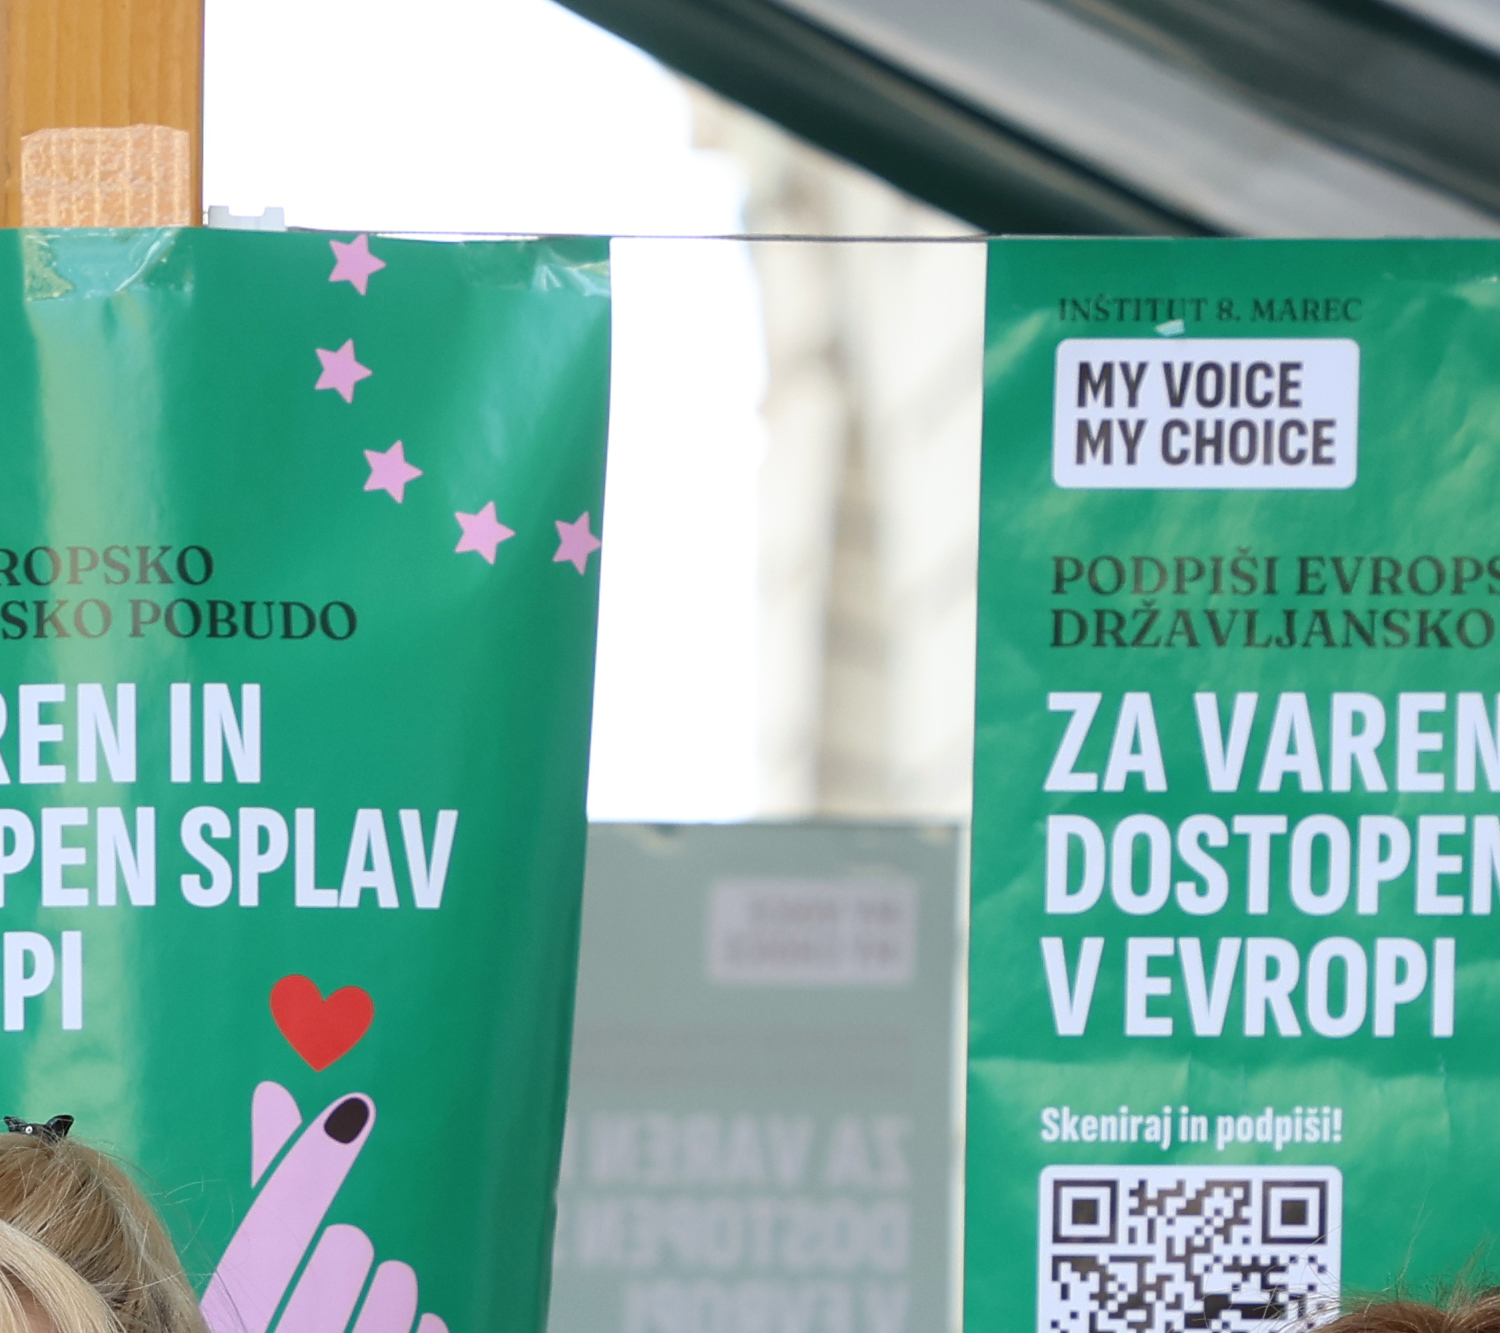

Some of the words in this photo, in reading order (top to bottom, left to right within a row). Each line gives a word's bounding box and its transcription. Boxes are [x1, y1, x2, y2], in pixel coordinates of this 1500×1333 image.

[1058, 295, 1207, 324] INŠTITUT
[1215, 299, 1242, 323] 8.
[1251, 298, 1363, 323] MAREC
[1076, 361, 1147, 408] MY
[1161, 361, 1303, 408] VOICE
[1075, 418, 1147, 467] MY
[1160, 418, 1336, 468] CHOICE
[1050, 547, 1279, 596] PODPIŠI
[128, 598, 358, 641] POBUDO
[1049, 603, 1496, 651] DRŽAVLJANSKO
[170, 682, 263, 785] IN
[1042, 693, 1168, 793] ZA
[180, 807, 459, 911] SPLAV
[1040, 936, 1104, 1037] V
[1124, 935, 1455, 1038] EVROPI
[1040, 1106, 1173, 1150] Skeniraj
[1178, 1108, 1205, 1143] in
[1214, 1107, 1343, 1151] podpiši!
